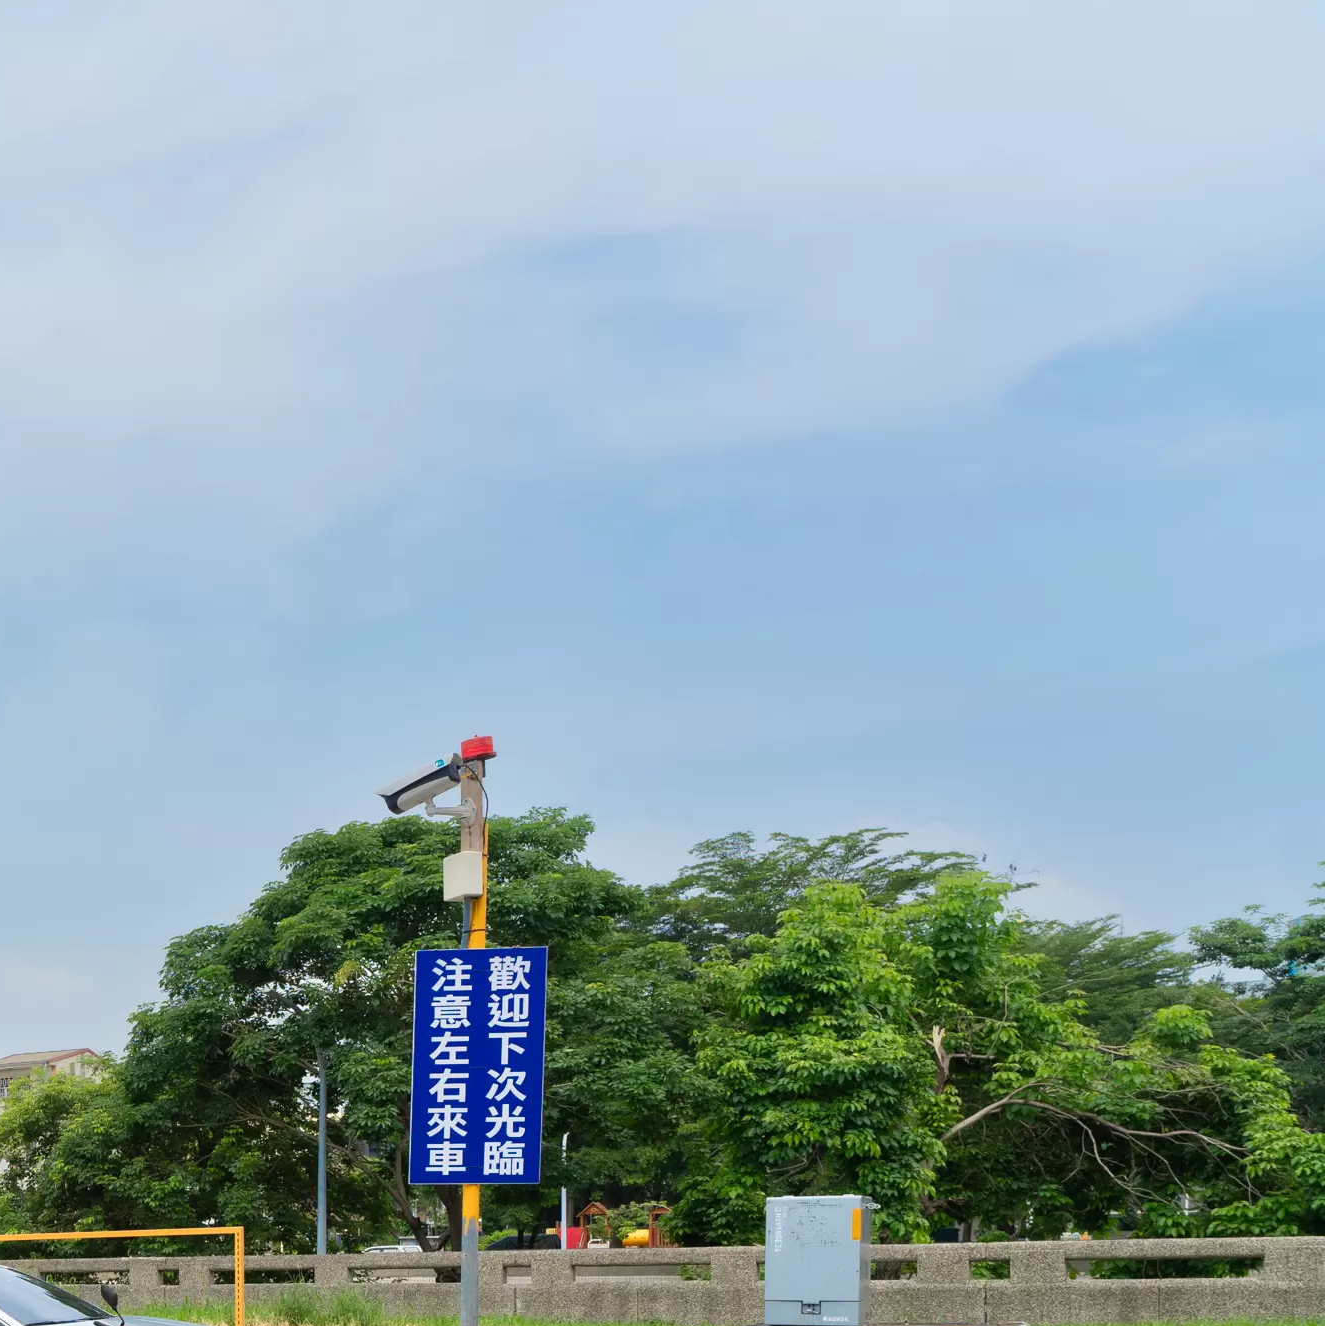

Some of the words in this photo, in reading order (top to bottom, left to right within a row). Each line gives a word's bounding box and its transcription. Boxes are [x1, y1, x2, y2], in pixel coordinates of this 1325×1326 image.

[425, 957, 473, 1176] 注意左右來車
[482, 955, 532, 1176] 歡迎下次光臨
